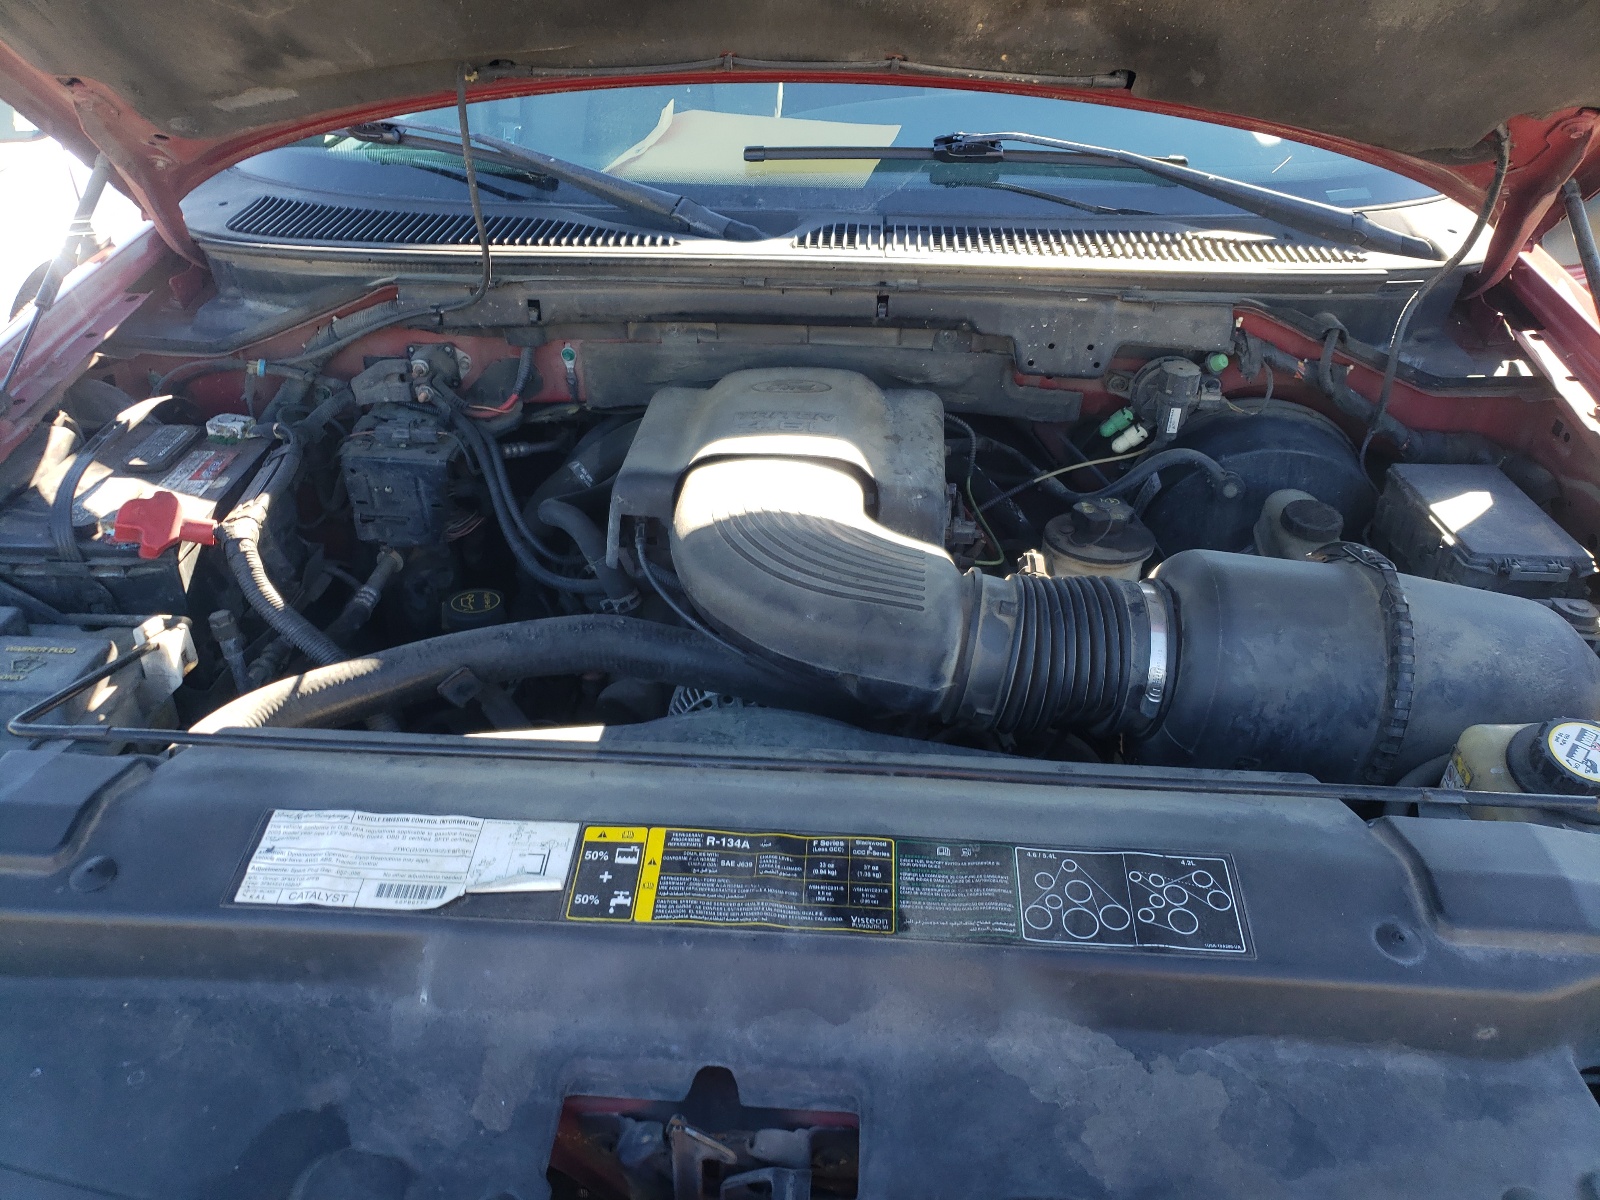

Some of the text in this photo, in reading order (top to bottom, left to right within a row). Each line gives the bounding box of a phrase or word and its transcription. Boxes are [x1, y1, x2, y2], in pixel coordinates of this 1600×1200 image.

[357, 814, 381, 822] VEHICLE
[411, 817, 438, 825] CONTROL
[440, 818, 479, 827] INFORMATION
[706, 835, 750, 850] R-134A
[820, 839, 845, 847] Series
[584, 850, 609, 861] 50%
[720, 859, 735, 867] SAE
[288, 891, 348, 903] CATALYST
[574, 894, 600, 905] 50%
[850, 915, 888, 925] Visteon
